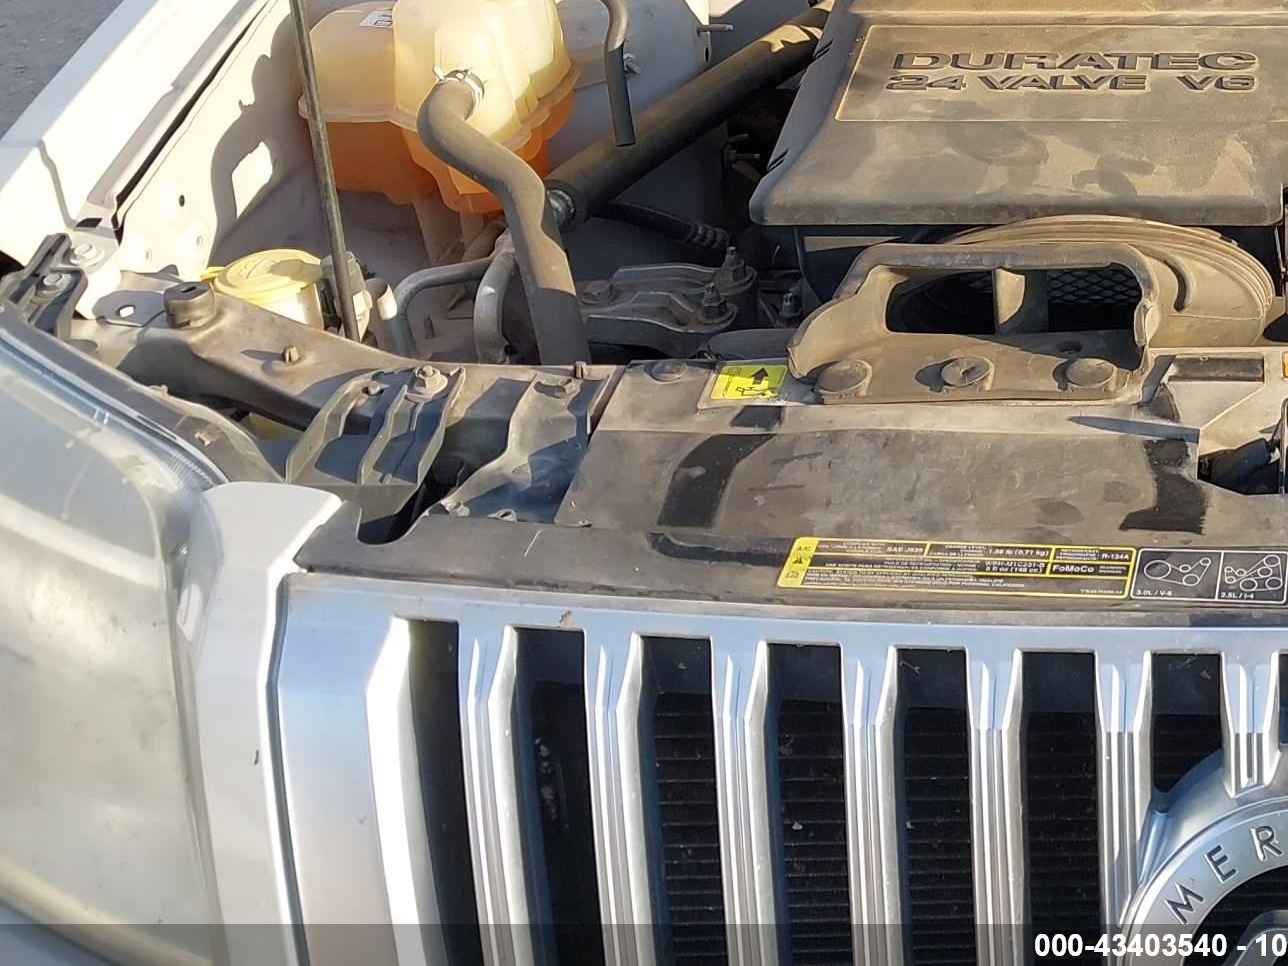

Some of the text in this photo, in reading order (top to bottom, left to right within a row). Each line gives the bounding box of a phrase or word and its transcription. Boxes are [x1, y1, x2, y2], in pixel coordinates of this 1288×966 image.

[891, 51, 1260, 71] DURATEC
[885, 74, 1256, 91] 24 VALVE V6
[1052, 564, 1095, 573] FoMoCo
